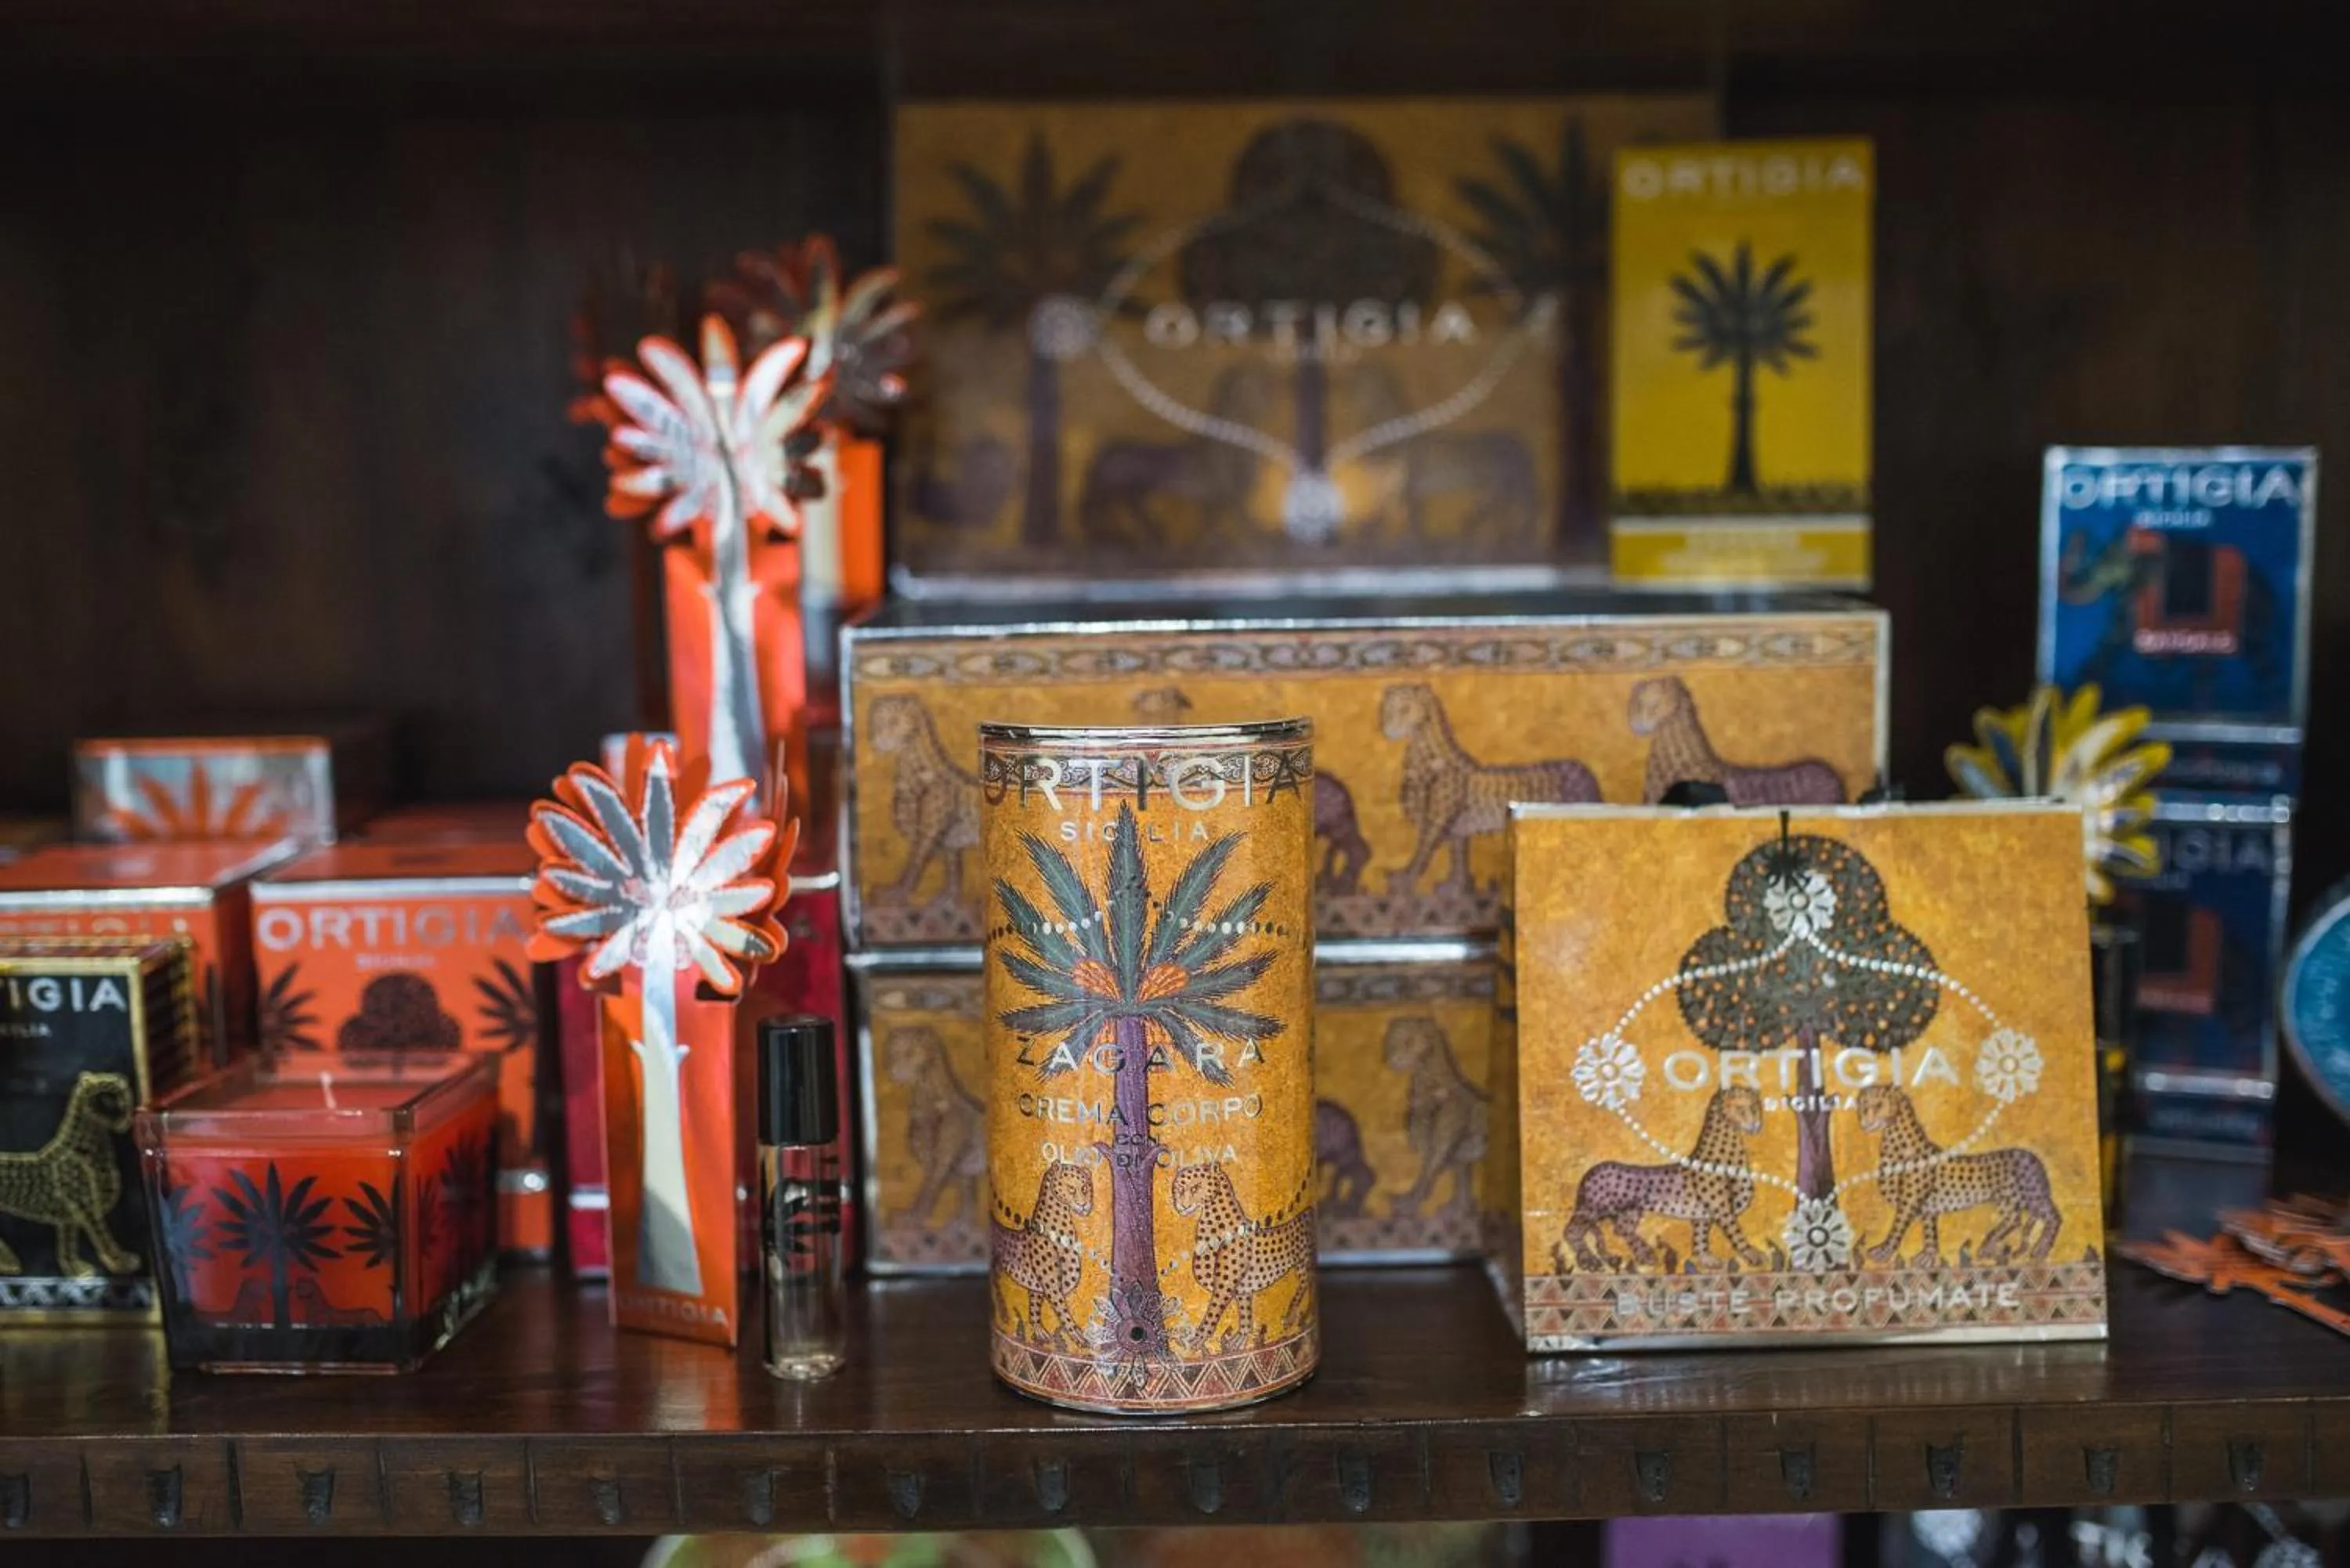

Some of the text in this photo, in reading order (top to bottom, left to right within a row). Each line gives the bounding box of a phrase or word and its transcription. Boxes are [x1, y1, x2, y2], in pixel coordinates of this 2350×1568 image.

[1623, 155, 1865, 197] ORTIGIA
[1144, 299, 1479, 351] ORTIGIA
[2063, 465, 2299, 509] ORTIGIA
[982, 750, 1303, 812] ORTIGIA
[1061, 821, 1210, 842] SICLIA
[257, 905, 530, 951] ORTIGIA
[1015, 1035, 1266, 1074] ZAGARA
[1663, 1047, 1960, 1091] ORTIGIA
[1018, 1092, 1264, 1127] CREMA CORPO
[1762, 1096, 1858, 1113] SICILIA
[1615, 1281, 2021, 1316] BUSTE PROFUMATE
